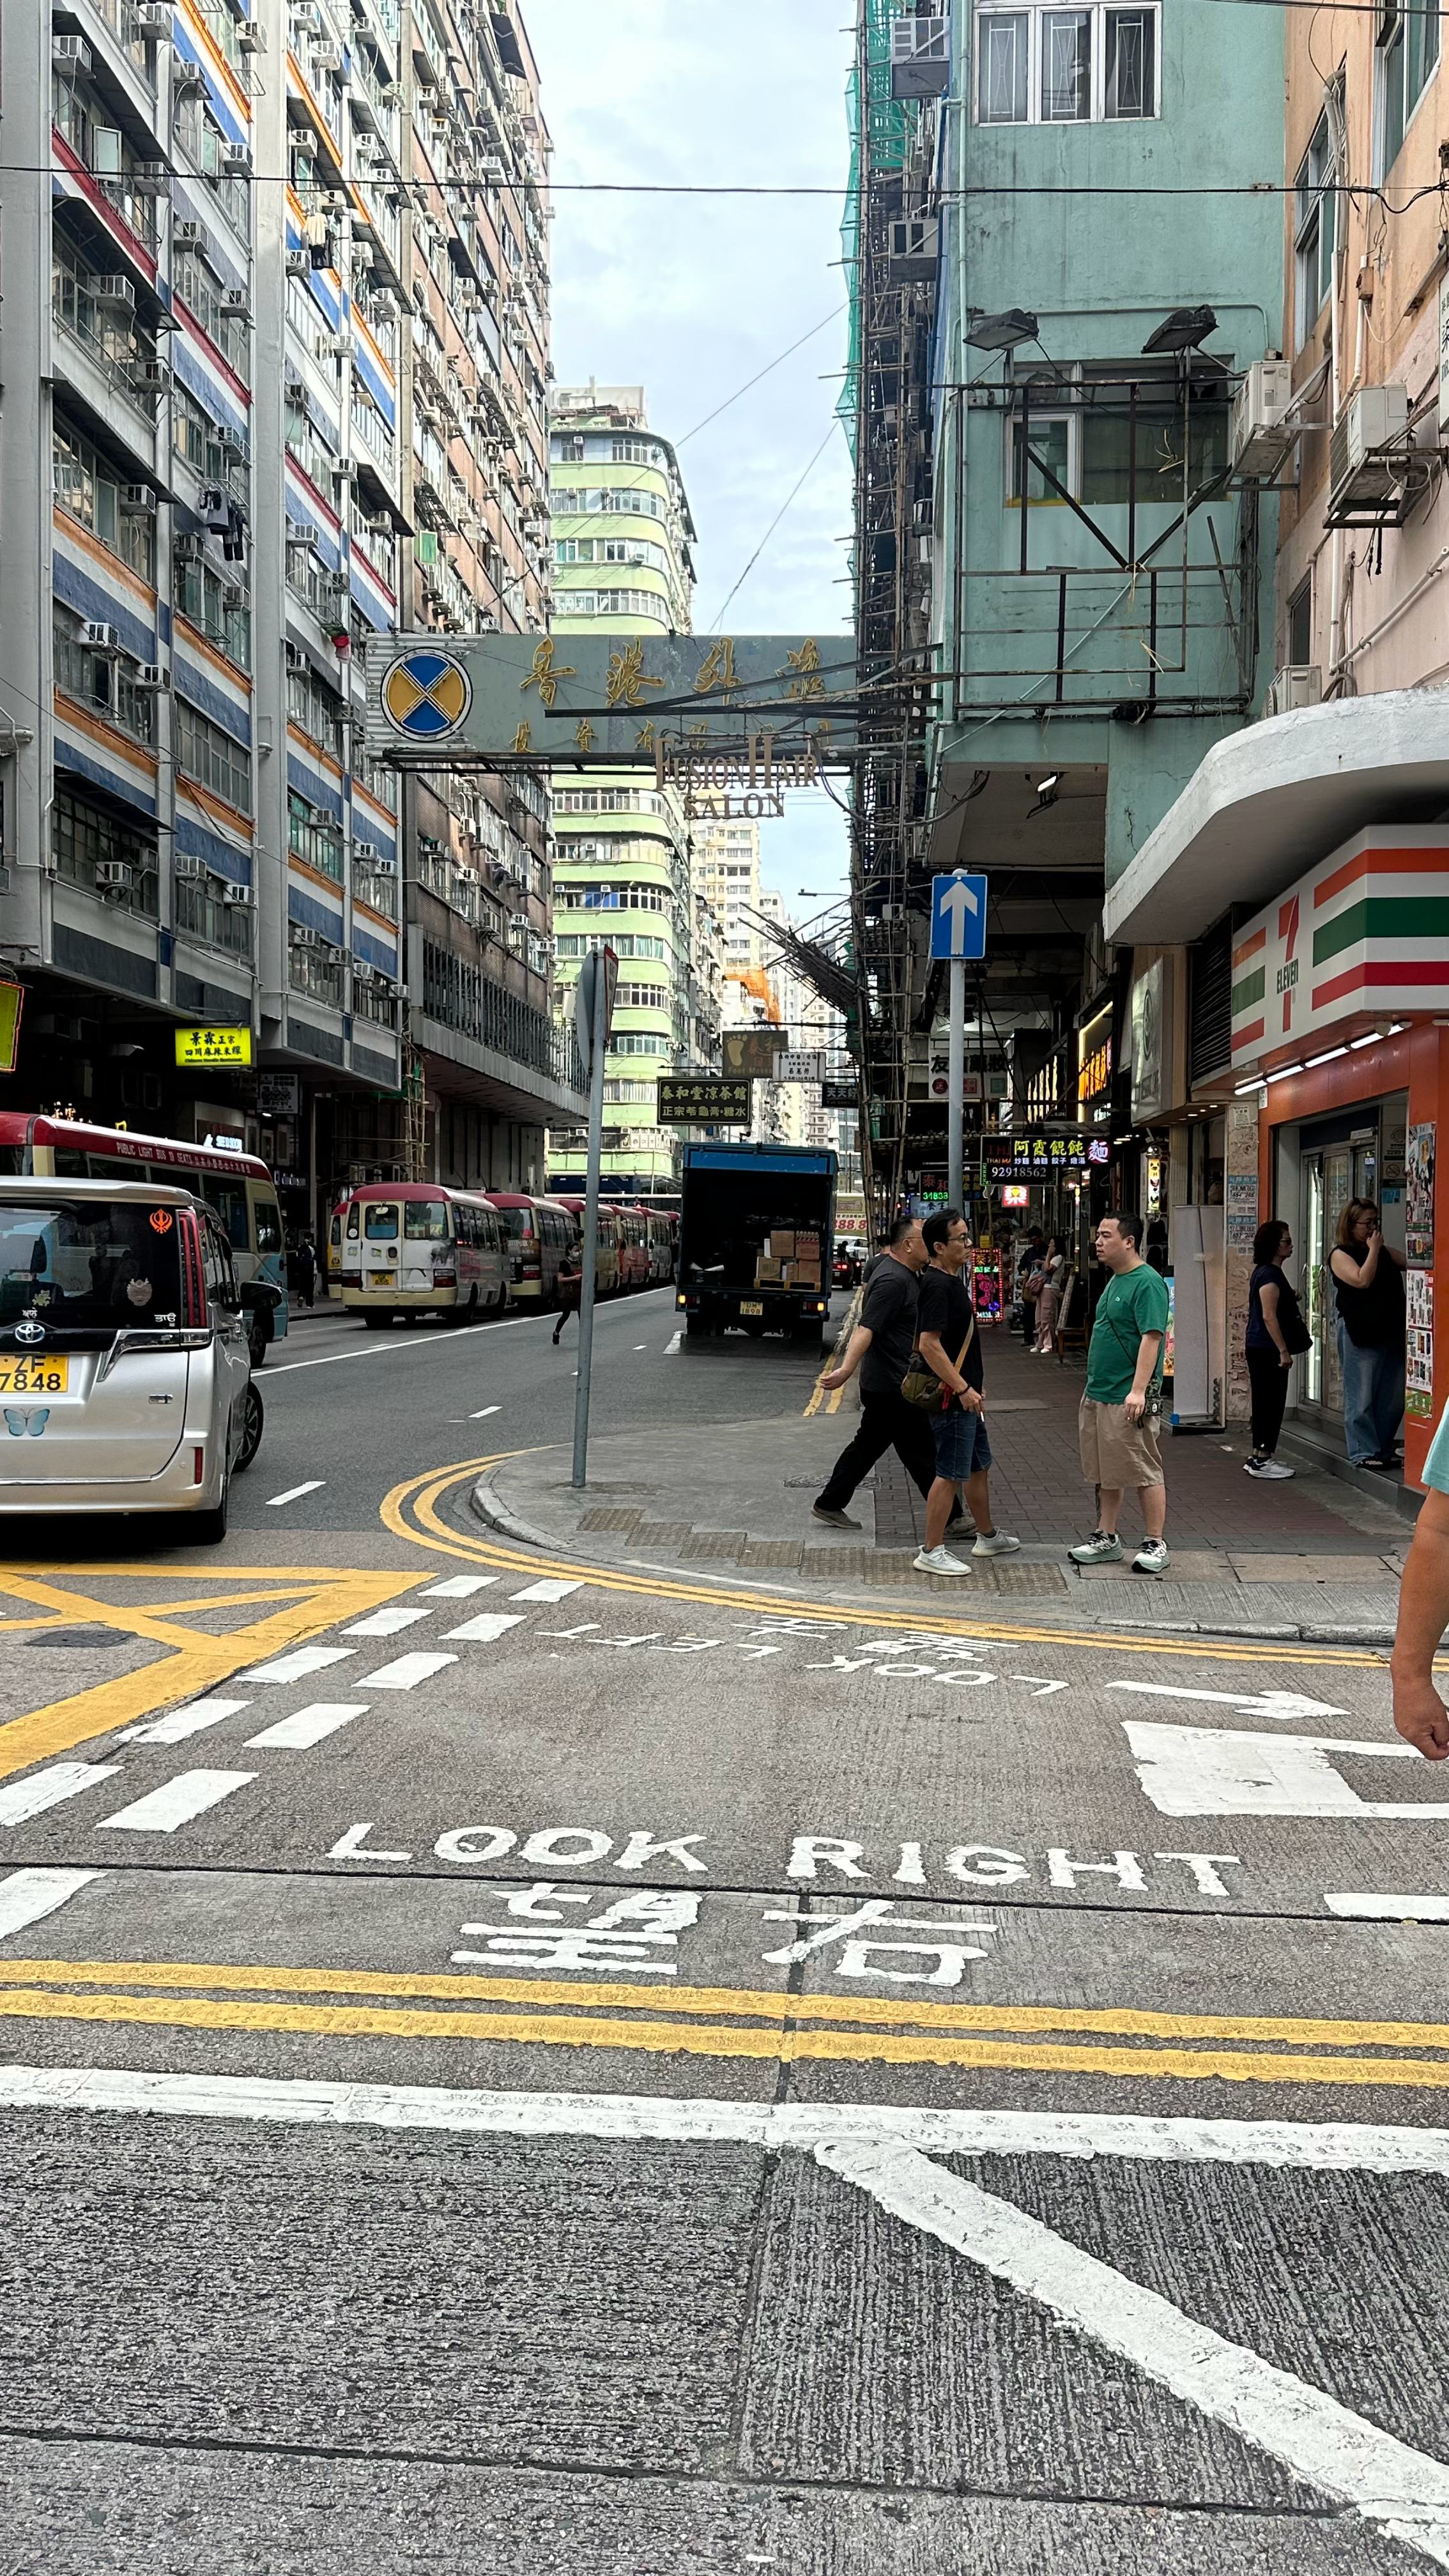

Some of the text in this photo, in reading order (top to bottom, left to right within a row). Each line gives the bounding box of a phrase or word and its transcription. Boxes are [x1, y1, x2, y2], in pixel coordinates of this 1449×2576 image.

[684, 792, 785, 820] SALON
[116, 1142, 136, 1156] PUBLIC
[992, 1167, 1046, 1177] 92918562
[14, 1355, 47, 1373] ZF
[0, 1372, 61, 1391] 7848
[533, 1623, 1070, 1697] LOOK LEFT
[325, 1822, 1243, 1897] LOOK RIGHT
[450, 1882, 998, 1988] 望右
